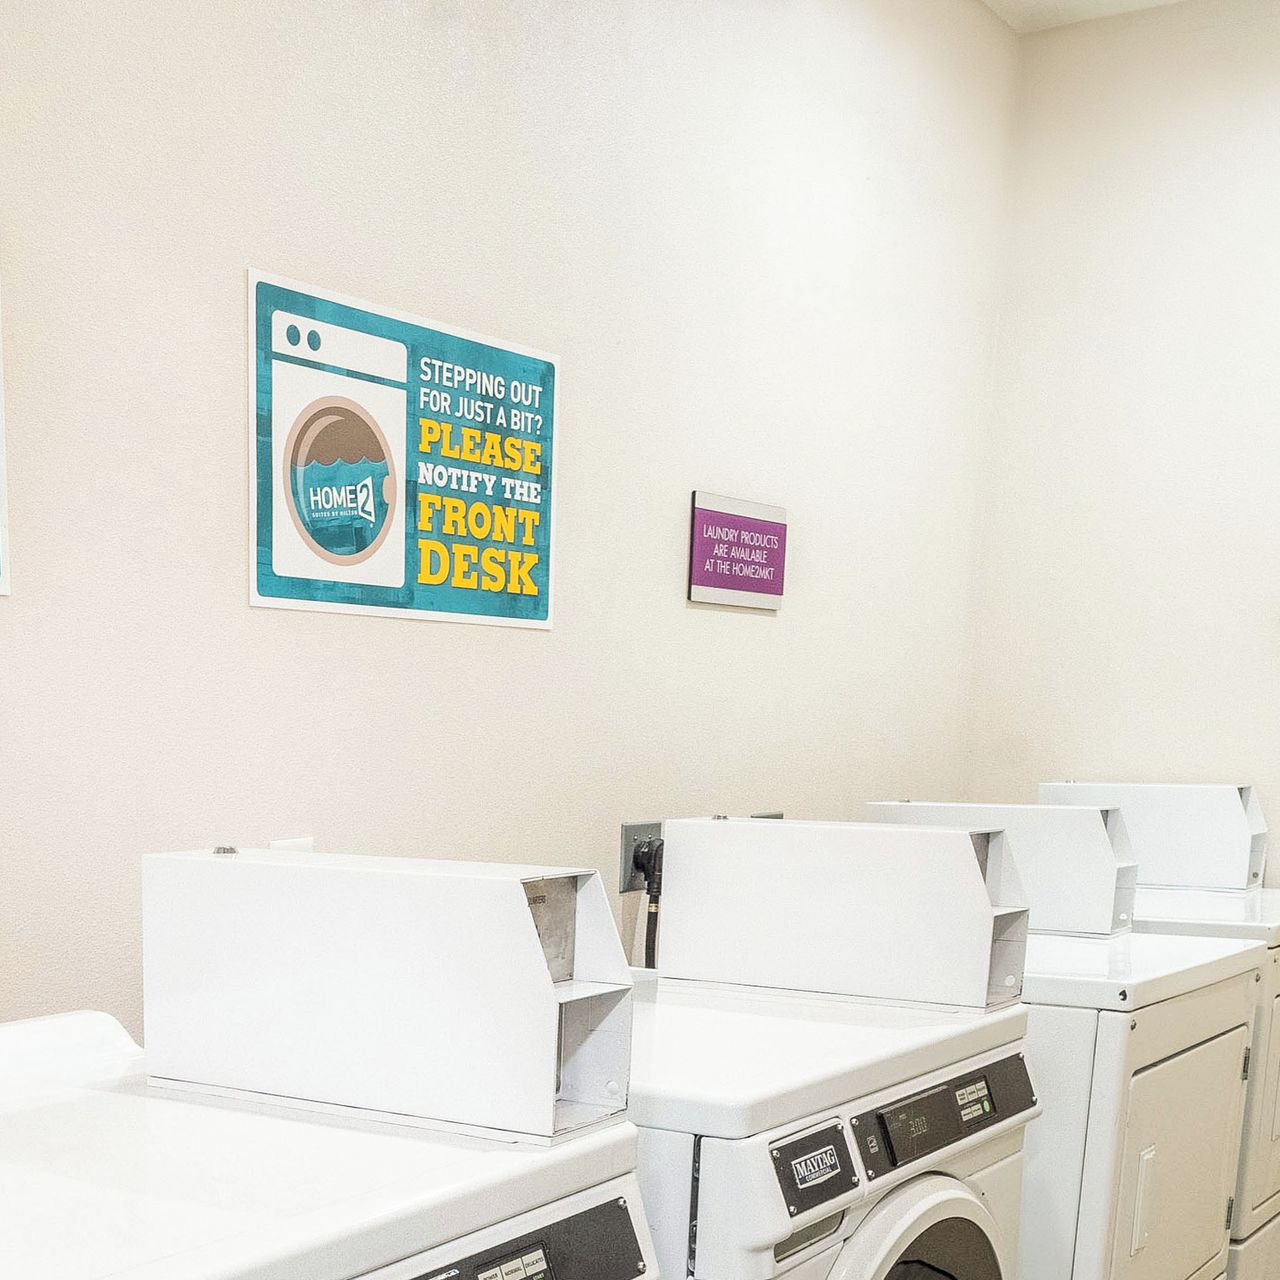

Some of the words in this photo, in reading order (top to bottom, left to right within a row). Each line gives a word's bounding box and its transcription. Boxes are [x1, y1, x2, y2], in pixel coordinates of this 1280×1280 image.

[419, 356, 506, 400] STEPPING
[510, 380, 543, 409] OUT
[419, 387, 451, 415] FOR
[454, 396, 494, 424] JUST
[495, 406, 507, 428] A
[510, 408, 543, 435] BIT?
[418, 417, 542, 475] PLEASE
[418, 461, 497, 496] NOTIFY
[501, 477, 541, 504] THE
[417, 492, 541, 546] FRONT
[703, 524, 739, 543] LAUNDRY
[740, 530, 778, 549] PRODUCTS
[417, 538, 540, 597] DESK
[704, 558, 715, 572] AT
[716, 560, 730, 575] THE
[713, 543, 729, 558] ARE
[730, 546, 768, 563] AVAILABLE
[795, 1149, 836, 1179] MAYTAG
